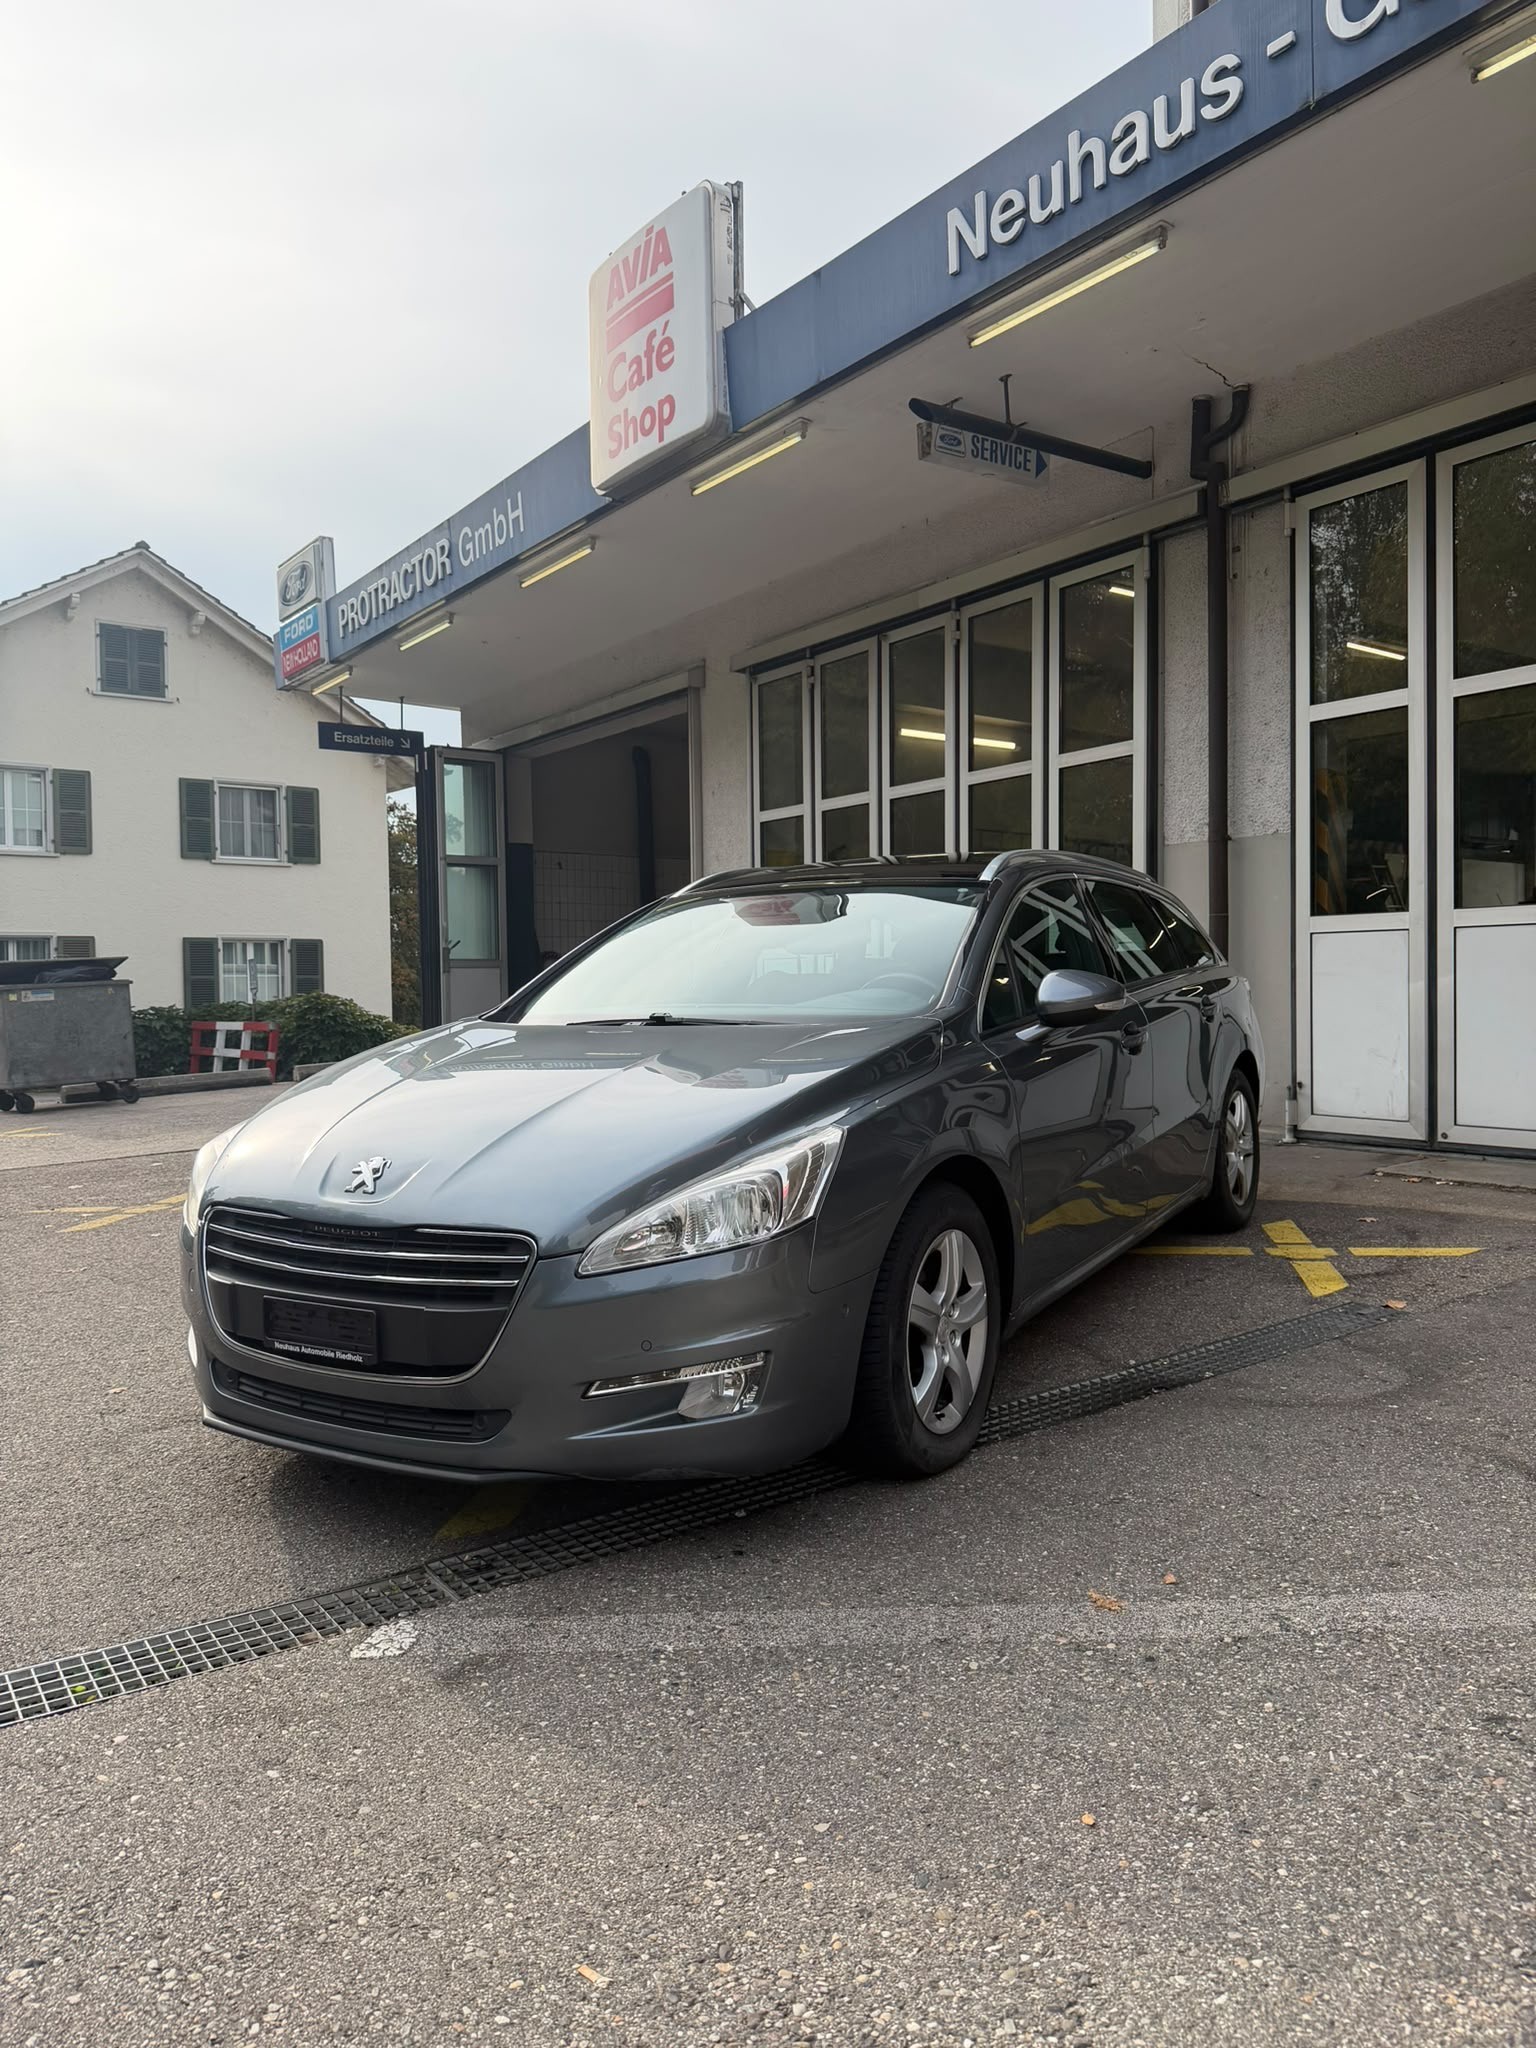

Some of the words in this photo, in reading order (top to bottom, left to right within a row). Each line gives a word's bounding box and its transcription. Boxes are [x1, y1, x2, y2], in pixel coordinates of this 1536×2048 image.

[947, 54, 1244, 275] Neuhaus
[607, 320, 675, 403] Café
[608, 394, 676, 460] Shop
[971, 434, 1032, 472] SERVICE
[337, 538, 452, 639] PROTRACTOR
[458, 491, 525, 567] GmbH
[284, 614, 314, 643] FORD
[294, 639, 319, 667] HOLLAND
[333, 731, 395, 748] Ersatzteile
[274, 1341, 300, 1352] Neuhaus
[301, 1346, 334, 1358] Automobile
[336, 1351, 363, 1363] Riedholz
